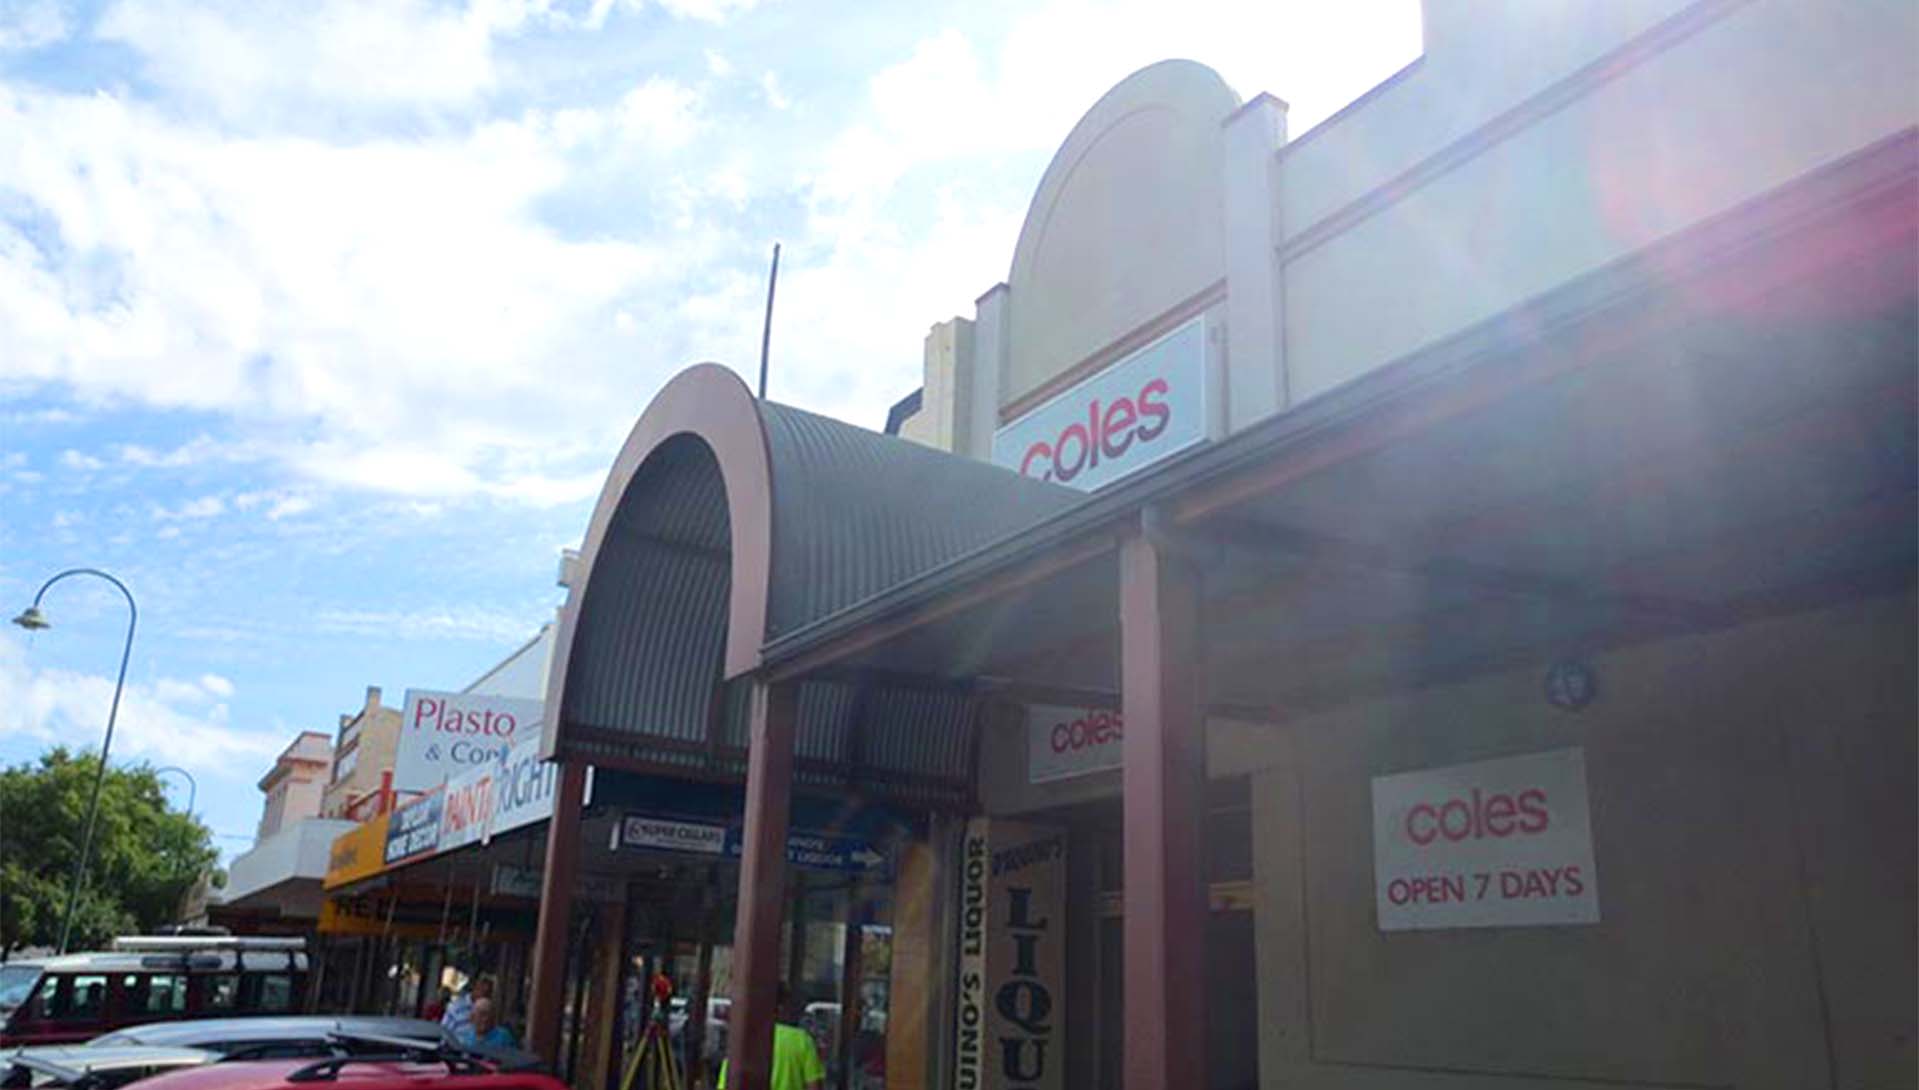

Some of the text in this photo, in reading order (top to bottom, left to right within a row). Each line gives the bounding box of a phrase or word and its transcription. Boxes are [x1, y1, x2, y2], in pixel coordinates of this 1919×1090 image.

[1020, 378, 1170, 482] coles
[414, 699, 516, 737] Plasto
[1051, 708, 1123, 753] coles
[425, 744, 440, 762] &
[1406, 788, 1550, 846] coles
[964, 838, 984, 956] LIQUOR
[1387, 867, 1584, 906] OPEN 7 DAYS
[995, 885, 1052, 1090] LIQU
